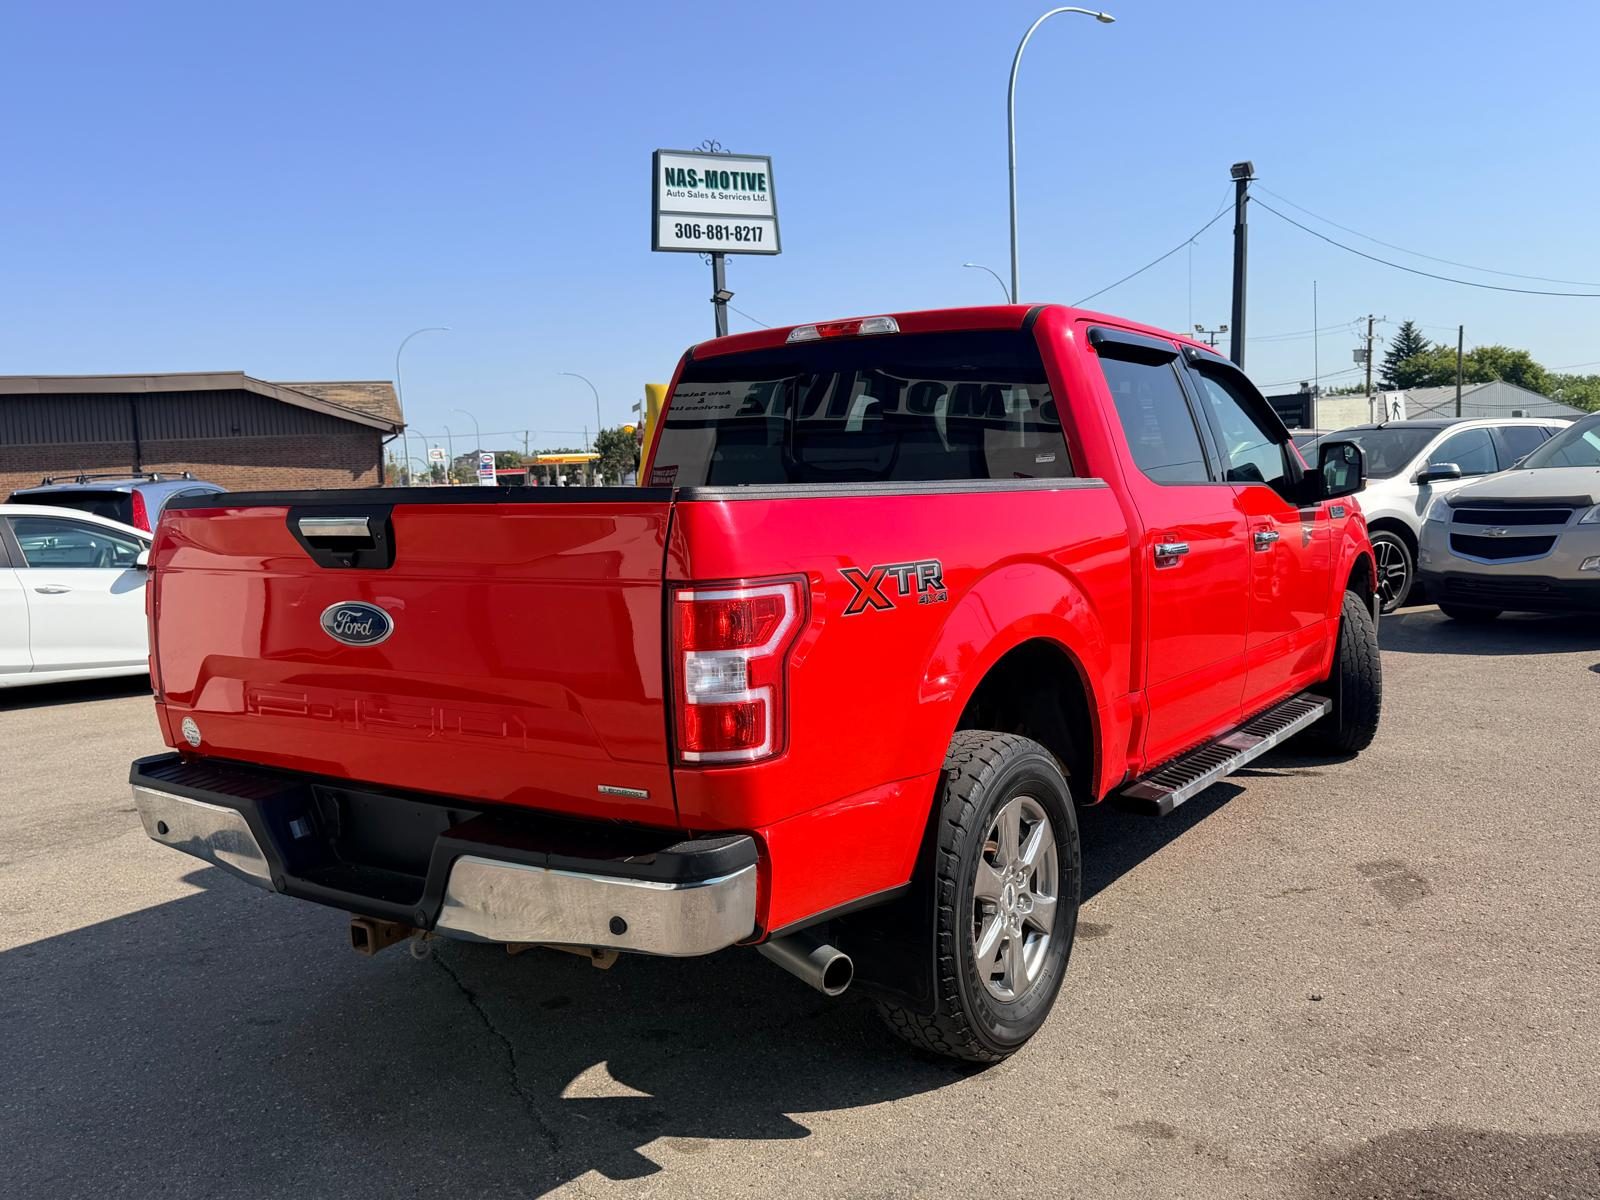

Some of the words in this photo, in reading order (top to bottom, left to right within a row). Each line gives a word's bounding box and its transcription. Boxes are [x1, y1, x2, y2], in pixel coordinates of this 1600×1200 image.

[664, 166, 767, 192] NAS-MOTIVE
[666, 189, 686, 198] Auto
[687, 190, 709, 199] Sales
[718, 192, 751, 201] Services
[752, 193, 767, 202] Ltd.
[674, 222, 763, 242] 306-881-8217
[838, 559, 948, 616] XTR
[334, 609, 373, 635] Ford
